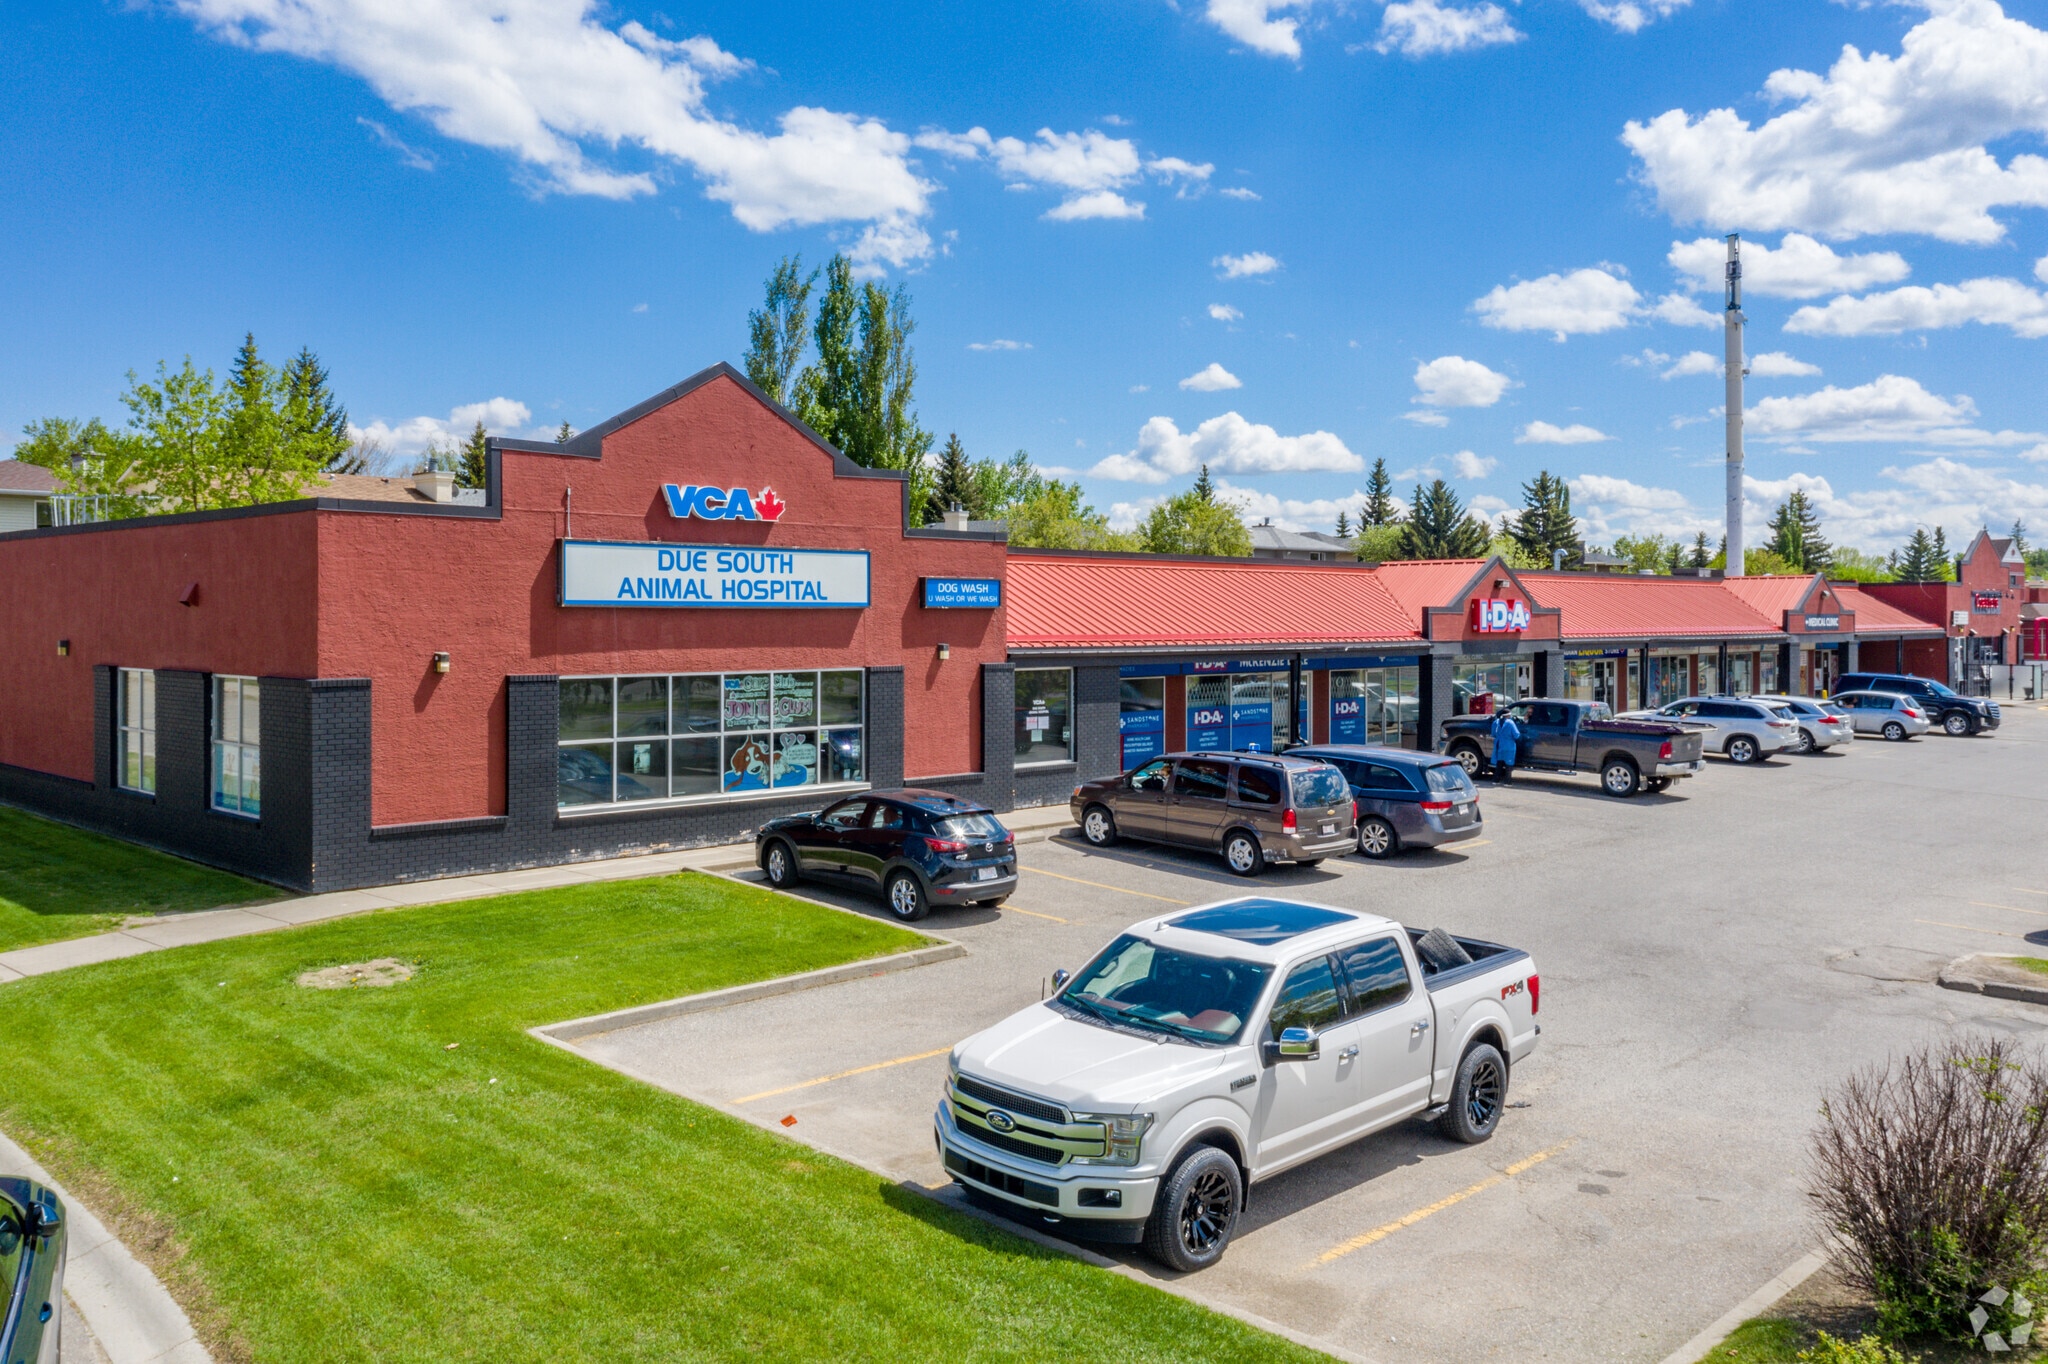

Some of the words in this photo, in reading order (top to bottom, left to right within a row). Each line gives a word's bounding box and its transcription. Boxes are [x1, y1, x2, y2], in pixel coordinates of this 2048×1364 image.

[664, 484, 757, 521] VCA
[657, 550, 708, 573] DUE
[716, 552, 794, 575] SOUTH
[617, 577, 713, 600] ANIMAL
[721, 579, 829, 601] HOSPITAL
[937, 582, 958, 593] DOG
[960, 583, 989, 594] WASH
[927, 594, 934, 602] U
[1578, 648, 1604, 657] LIQUOR
[725, 700, 755, 719] JOIN
[1127, 714, 1160, 724] SANDSTONE
[1501, 980, 1524, 1000] FX4
